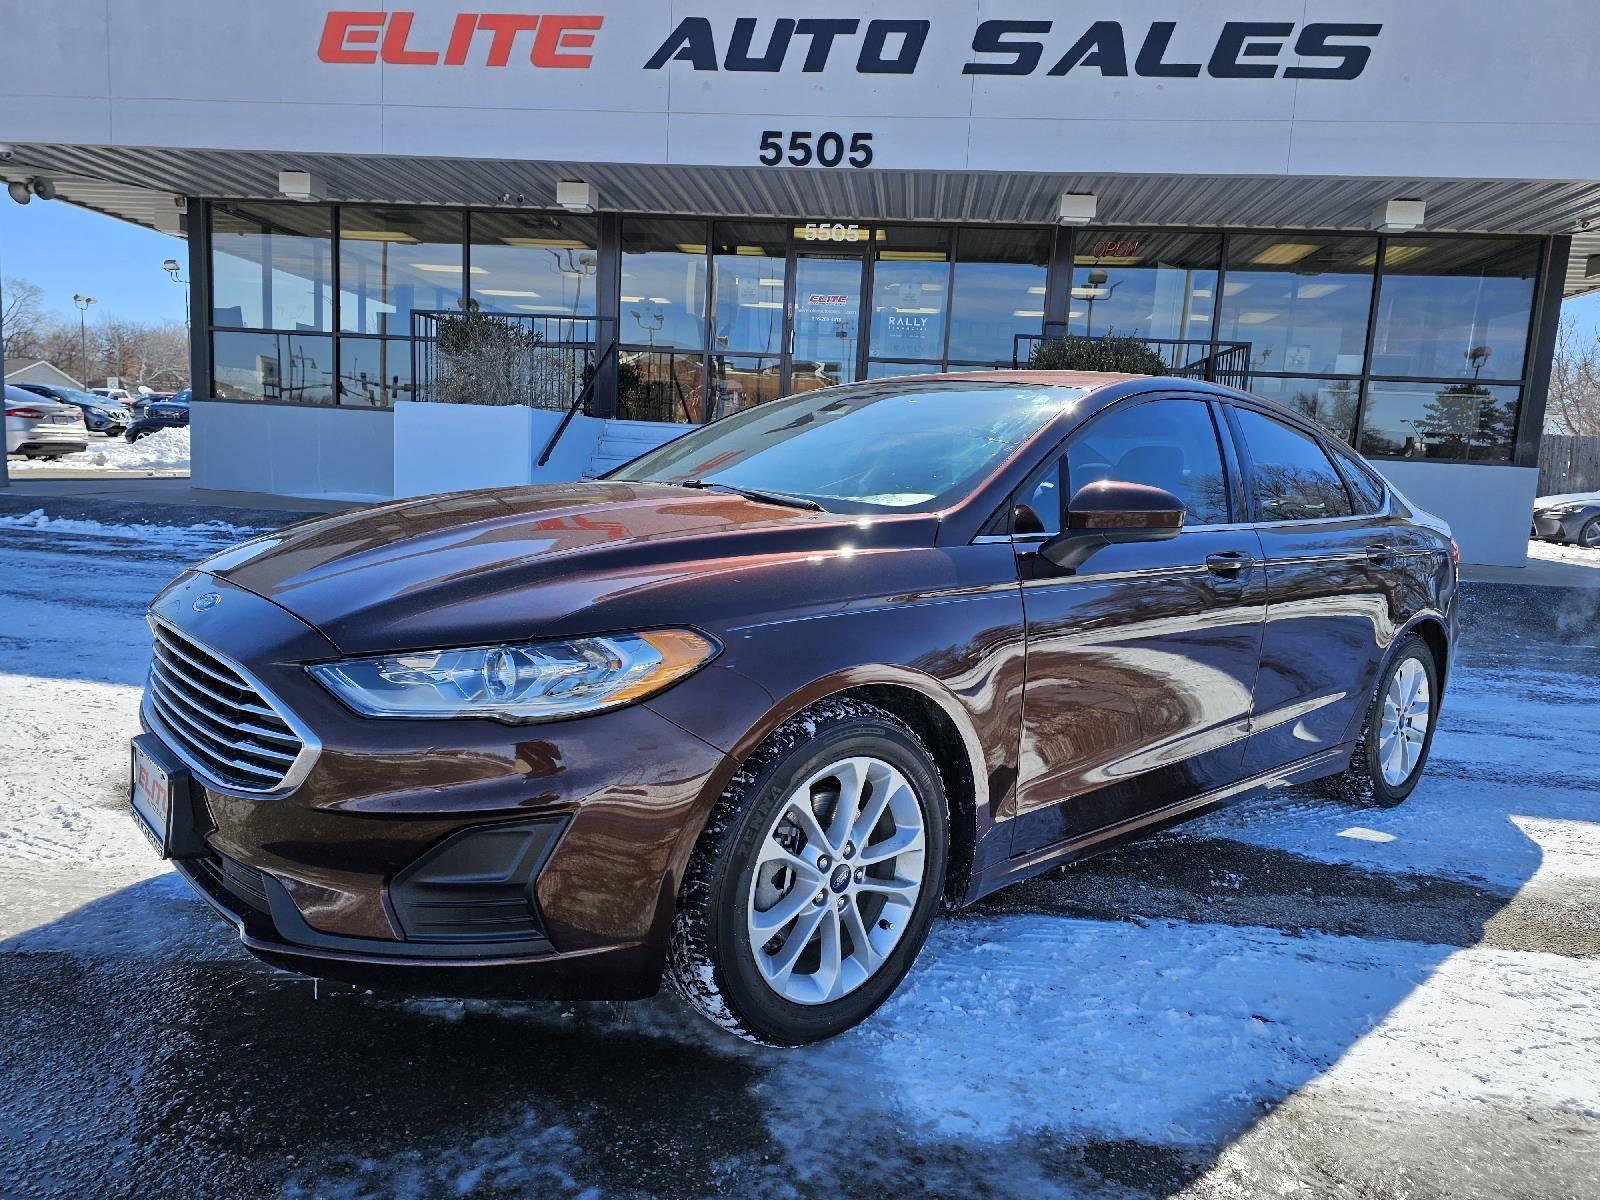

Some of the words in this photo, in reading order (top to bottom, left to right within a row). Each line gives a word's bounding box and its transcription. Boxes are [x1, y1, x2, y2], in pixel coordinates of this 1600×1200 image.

[317, 11, 604, 69] ELITE
[642, 16, 931, 75] AUTO
[961, 19, 1383, 81] SALES
[759, 130, 874, 169] 5505
[805, 223, 860, 242] 5505
[1093, 240, 1140, 258] OPEN
[809, 294, 849, 304] ELITE
[888, 316, 928, 327] RALLY
